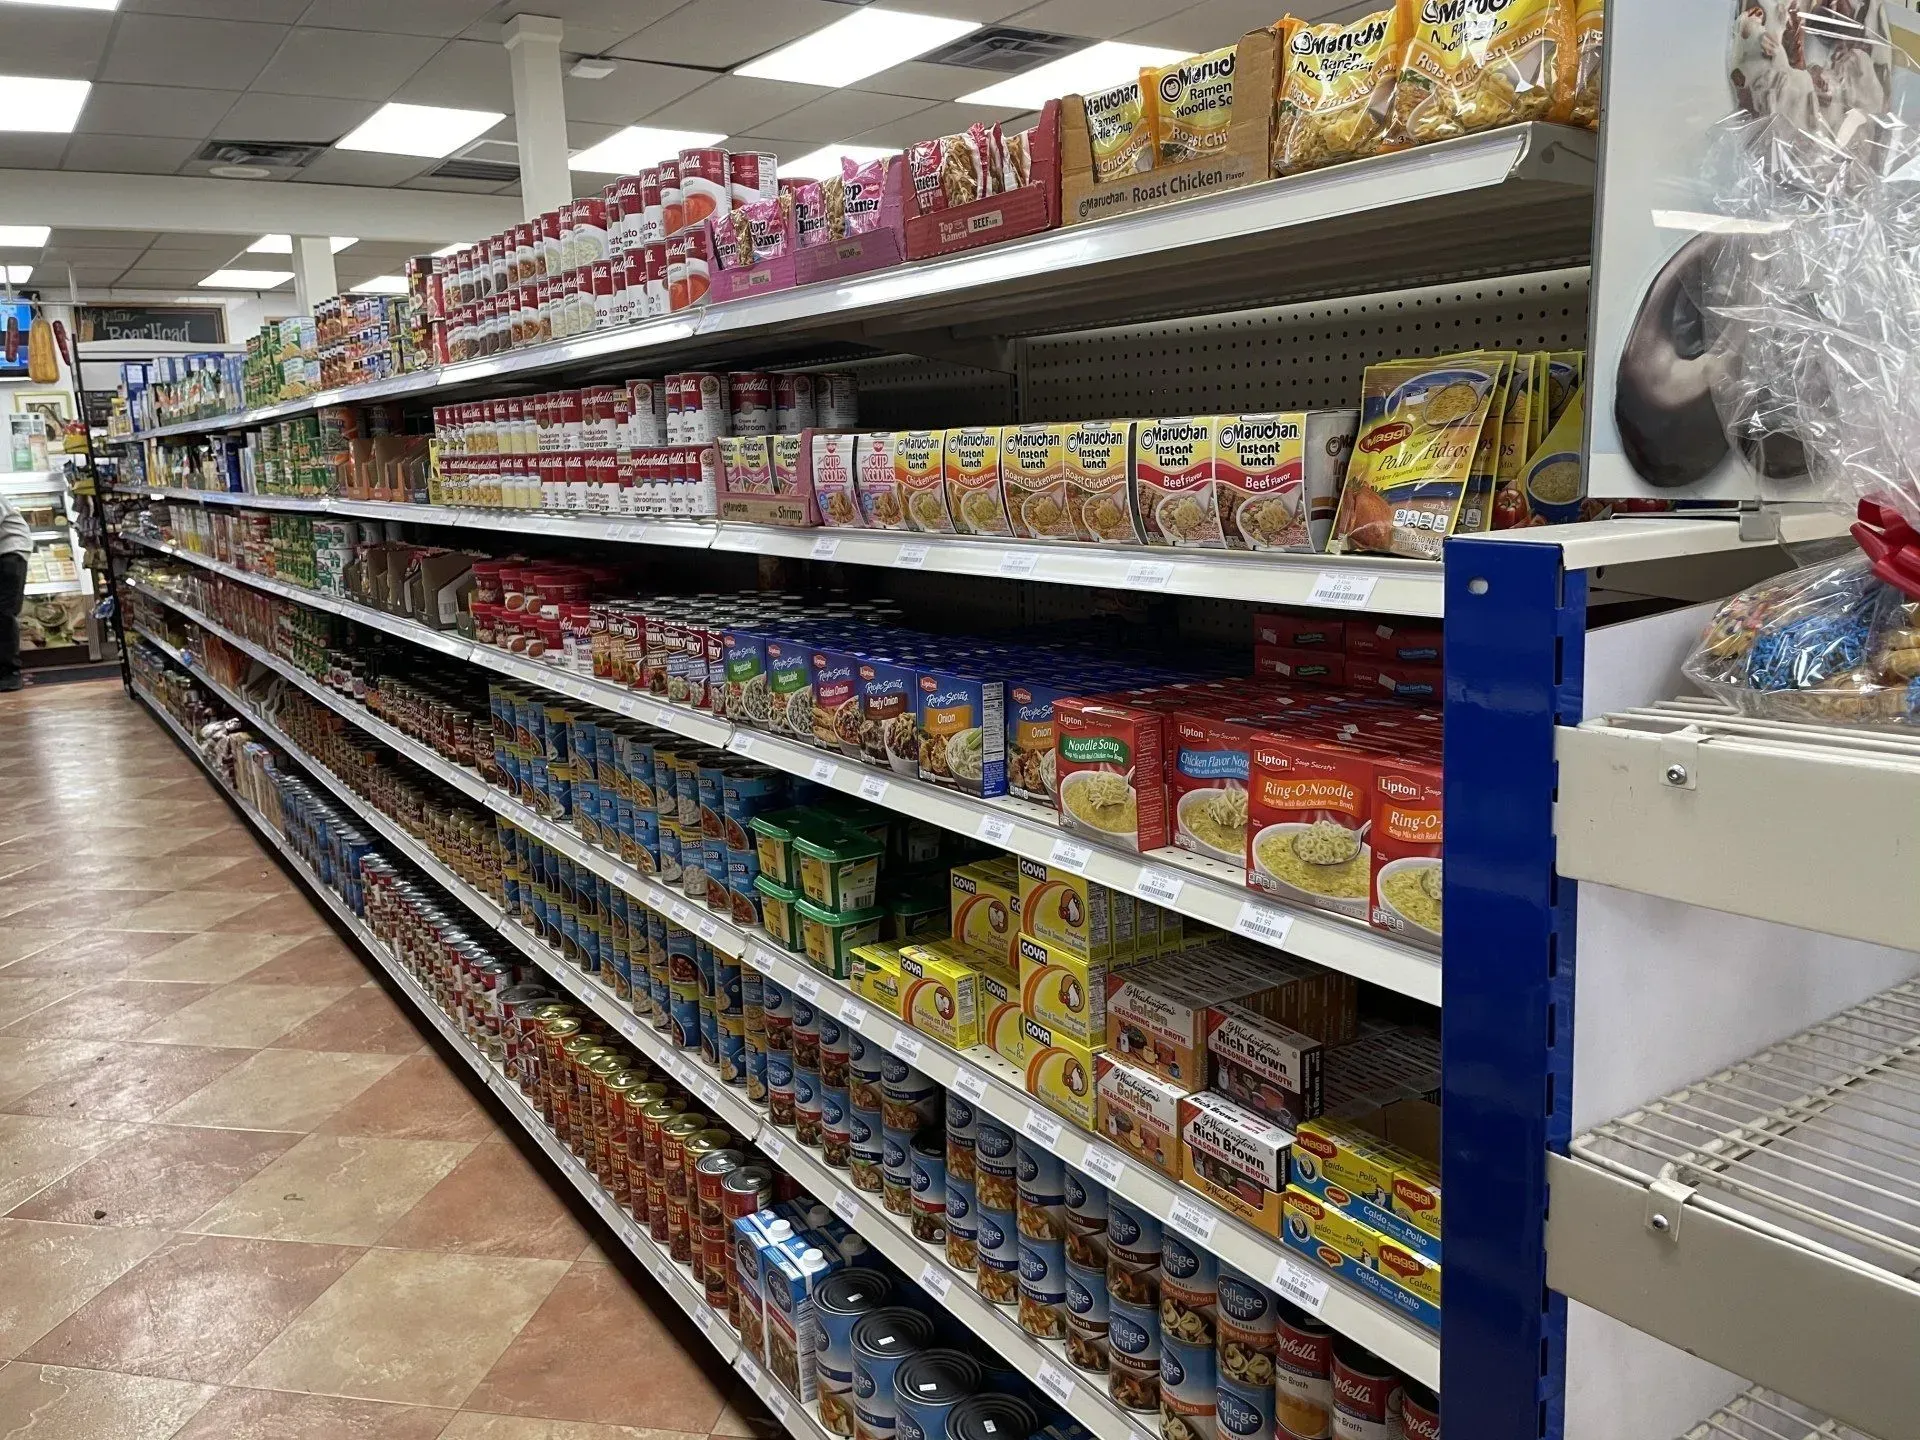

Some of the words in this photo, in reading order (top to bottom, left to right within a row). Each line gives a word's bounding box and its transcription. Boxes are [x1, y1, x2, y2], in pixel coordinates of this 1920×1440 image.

[1190, 82, 1232, 101] Ramen
[1133, 183, 1166, 203] Roast
[1170, 169, 1223, 194] Chicken
[1076, 430, 1123, 446] Maruchan
[1152, 424, 1209, 441] Maruchan
[1233, 422, 1299, 441] Maruchan
[1366, 428, 1407, 448] Maggi
[905, 437, 939, 450] Maruchan
[956, 433, 995, 447] Maruchan
[1014, 432, 1061, 448] Maruchan
[1237, 441, 1280, 455] Instant
[906, 451, 929, 461] Instant
[958, 449, 984, 459] Instant
[1017, 449, 1049, 459] Instant
[1079, 447, 1111, 458] Instant
[1155, 443, 1193, 455] Instant
[1424, 441, 1469, 459] Fideos
[825, 454, 840, 469] CUP
[869, 453, 888, 469] CUP
[909, 460, 927, 470] Lunch
[961, 458, 982, 468] Lunch
[1021, 459, 1046, 469] Lunch
[1082, 458, 1107, 469] Lunch
[1159, 455, 1189, 466] Lunch
[1240, 454, 1275, 467] Lunch
[819, 467, 847, 483] NOODLES
[906, 472, 930, 485] Chicken
[958, 473, 984, 485] Chicken
[1004, 468, 1024, 484] Roast
[1024, 475, 1051, 489] Chicken
[1065, 468, 1084, 483] Roast
[1084, 475, 1111, 488] Chicken
[1163, 474, 1185, 488] Beef
[1185, 471, 1203, 484] Flavor
[1245, 474, 1270, 489] Beef
[1271, 472, 1291, 485] Flavor
[778, 505, 803, 521] Shrimp
[834, 684, 848, 695] Onion
[869, 697, 884, 710] Beefy
[883, 695, 899, 706] Onion
[926, 694, 947, 708] Recipe
[946, 690, 969, 704] Secrets
[937, 713, 956, 723] Onion
[1019, 706, 1041, 720] Recipe
[1060, 713, 1082, 726] Lipton
[1031, 727, 1051, 738] Onion
[1180, 725, 1203, 738] Lipton
[1068, 739, 1099, 751] Noodle
[1099, 739, 1119, 753] Soup
[1181, 752, 1207, 768] Chicken
[1208, 755, 1231, 768] Flavor
[1257, 751, 1288, 767] Lipton
[1294, 758, 1310, 767] Soup
[1311, 761, 1333, 772] Secrets
[1265, 781, 1354, 800] Ring-O-Noodle
[1381, 779, 1416, 796] Lipton
[1424, 786, 1442, 797] Soup
[1263, 794, 1275, 806] Soup
[1284, 799, 1296, 807] with
[1296, 799, 1306, 807] Real
[1307, 798, 1327, 806] Chicken
[1339, 799, 1354, 811] Broth
[1388, 827, 1402, 838] Soup
[1402, 829, 1412, 839] Mix
[1412, 830, 1425, 840] with
[1425, 831, 1437, 840] Real
[1021, 860, 1047, 881] GOYA
[953, 875, 976, 893] GOYA
[1021, 940, 1046, 962] GOYA
[901, 958, 922, 976] GOYA
[985, 979, 1007, 1000] GOYA
[1025, 1021, 1051, 1045] GOYA
[1114, 1006, 1150, 1029] SEASONING
[1152, 1023, 1163, 1034] and
[1164, 1028, 1186, 1044] BROTH
[1218, 1029, 1244, 1053] Rich
[1247, 1043, 1287, 1074] Brown
[1214, 1043, 1252, 1067] SEASONING
[1254, 1065, 1266, 1074] and
[1268, 1069, 1292, 1087] BROTH
[1102, 1087, 1136, 1112] SEASONING
[1137, 1109, 1147, 1120] and
[1149, 1115, 1170, 1132] BROTH
[1193, 1121, 1220, 1146] Rich
[1222, 1137, 1265, 1171] Brown
[1300, 1135, 1333, 1154] Maggi
[1189, 1134, 1229, 1166] SEASONING
[1231, 1159, 1244, 1170] and
[1245, 1164, 1270, 1184] BROTH
[1323, 1159, 1344, 1173] Caldo
[1359, 1170, 1378, 1184] Pollo
[1396, 1183, 1431, 1206] Maggi
[1289, 1197, 1320, 1216] Maggi
[1363, 1205, 1387, 1224] Caldo
[1406, 1227, 1428, 1246] Pollo
[1346, 1233, 1364, 1247] Pollo
[1117, 1248, 1138, 1262] broth
[1383, 1250, 1419, 1271] Maggi
[1355, 1267, 1379, 1286] Caldo
[1398, 1291, 1420, 1310] Pollo
[1409, 1277, 1432, 1292] Caldo
[1219, 1283, 1263, 1309] College
[1227, 1301, 1247, 1318] Inn
[1124, 1355, 1147, 1369] broth
[1288, 1376, 1309, 1390] Broth
[1217, 1393, 1258, 1423] College
[1224, 1413, 1242, 1431] Inn
[1342, 1417, 1362, 1433] Broth
